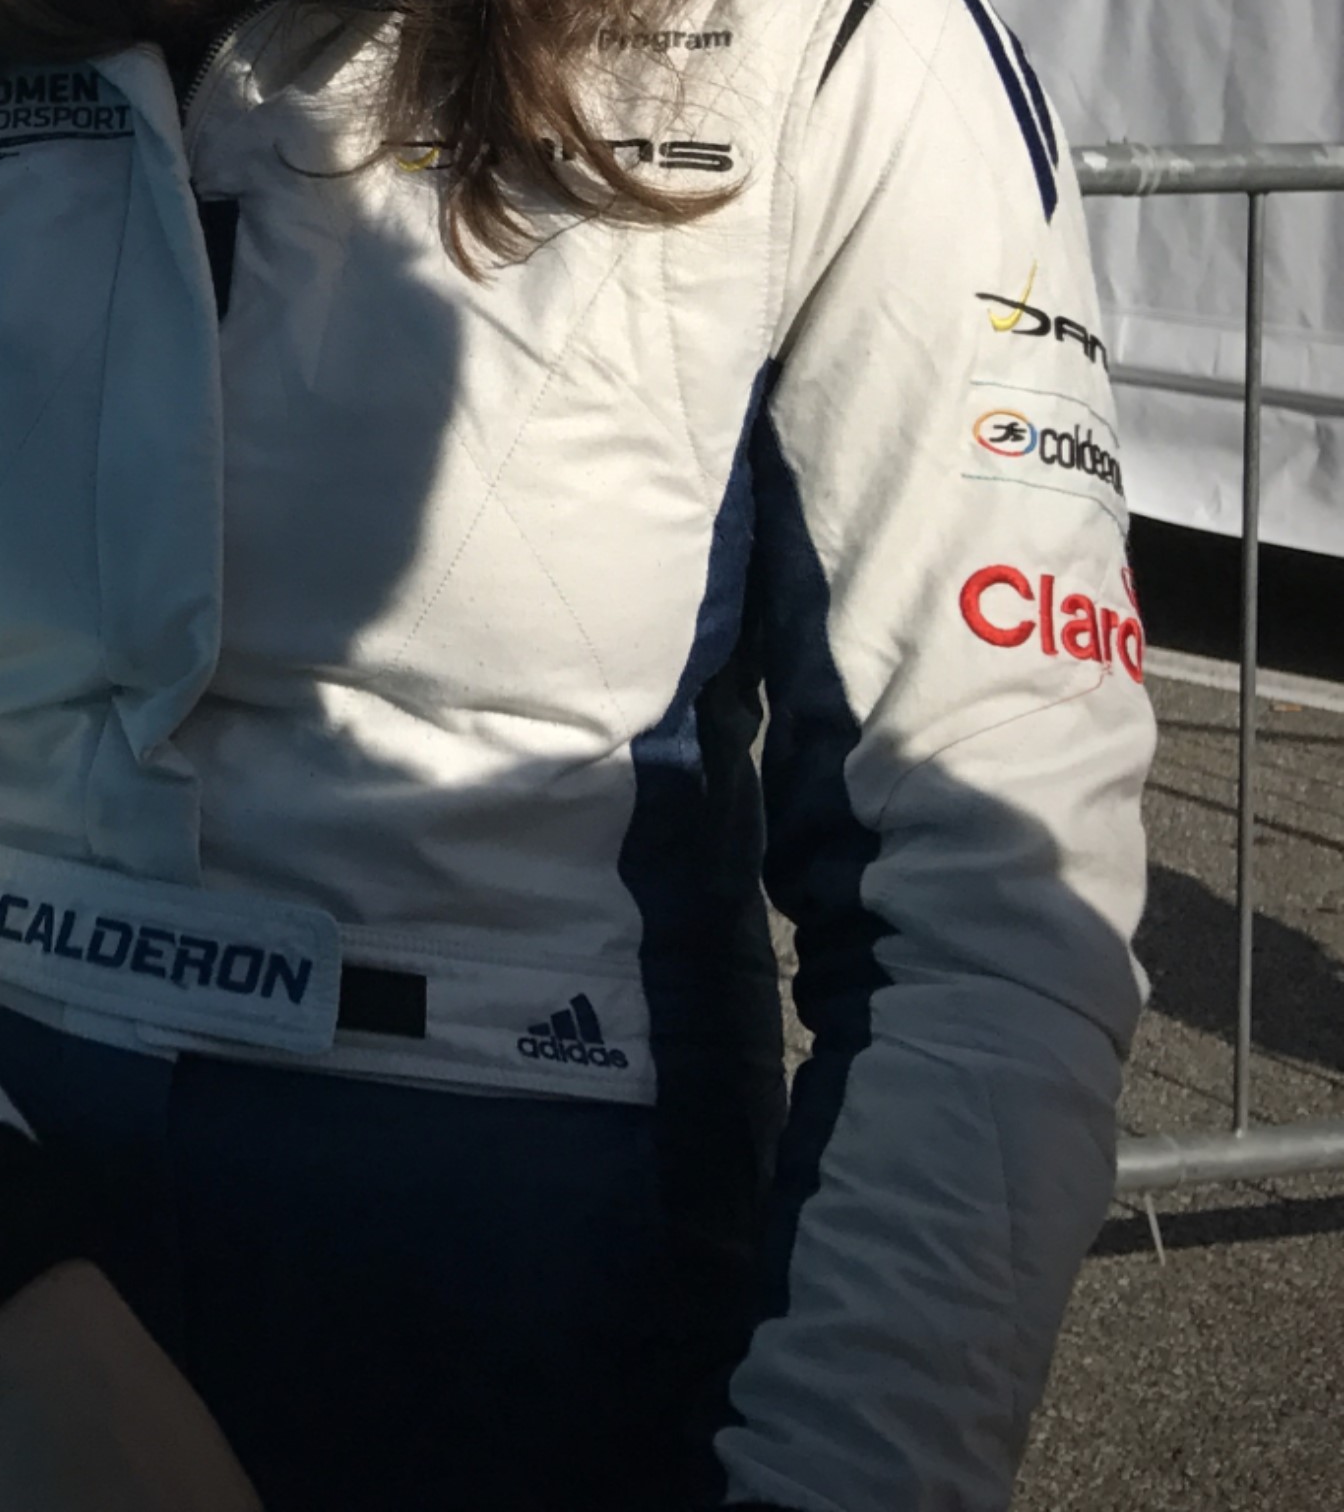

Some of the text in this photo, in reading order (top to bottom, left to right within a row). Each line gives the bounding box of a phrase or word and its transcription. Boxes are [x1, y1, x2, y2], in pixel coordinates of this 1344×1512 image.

[598, 28, 733, 51] Program
[959, 563, 1145, 684] Claro
[516, 1032, 630, 1070] adidas
